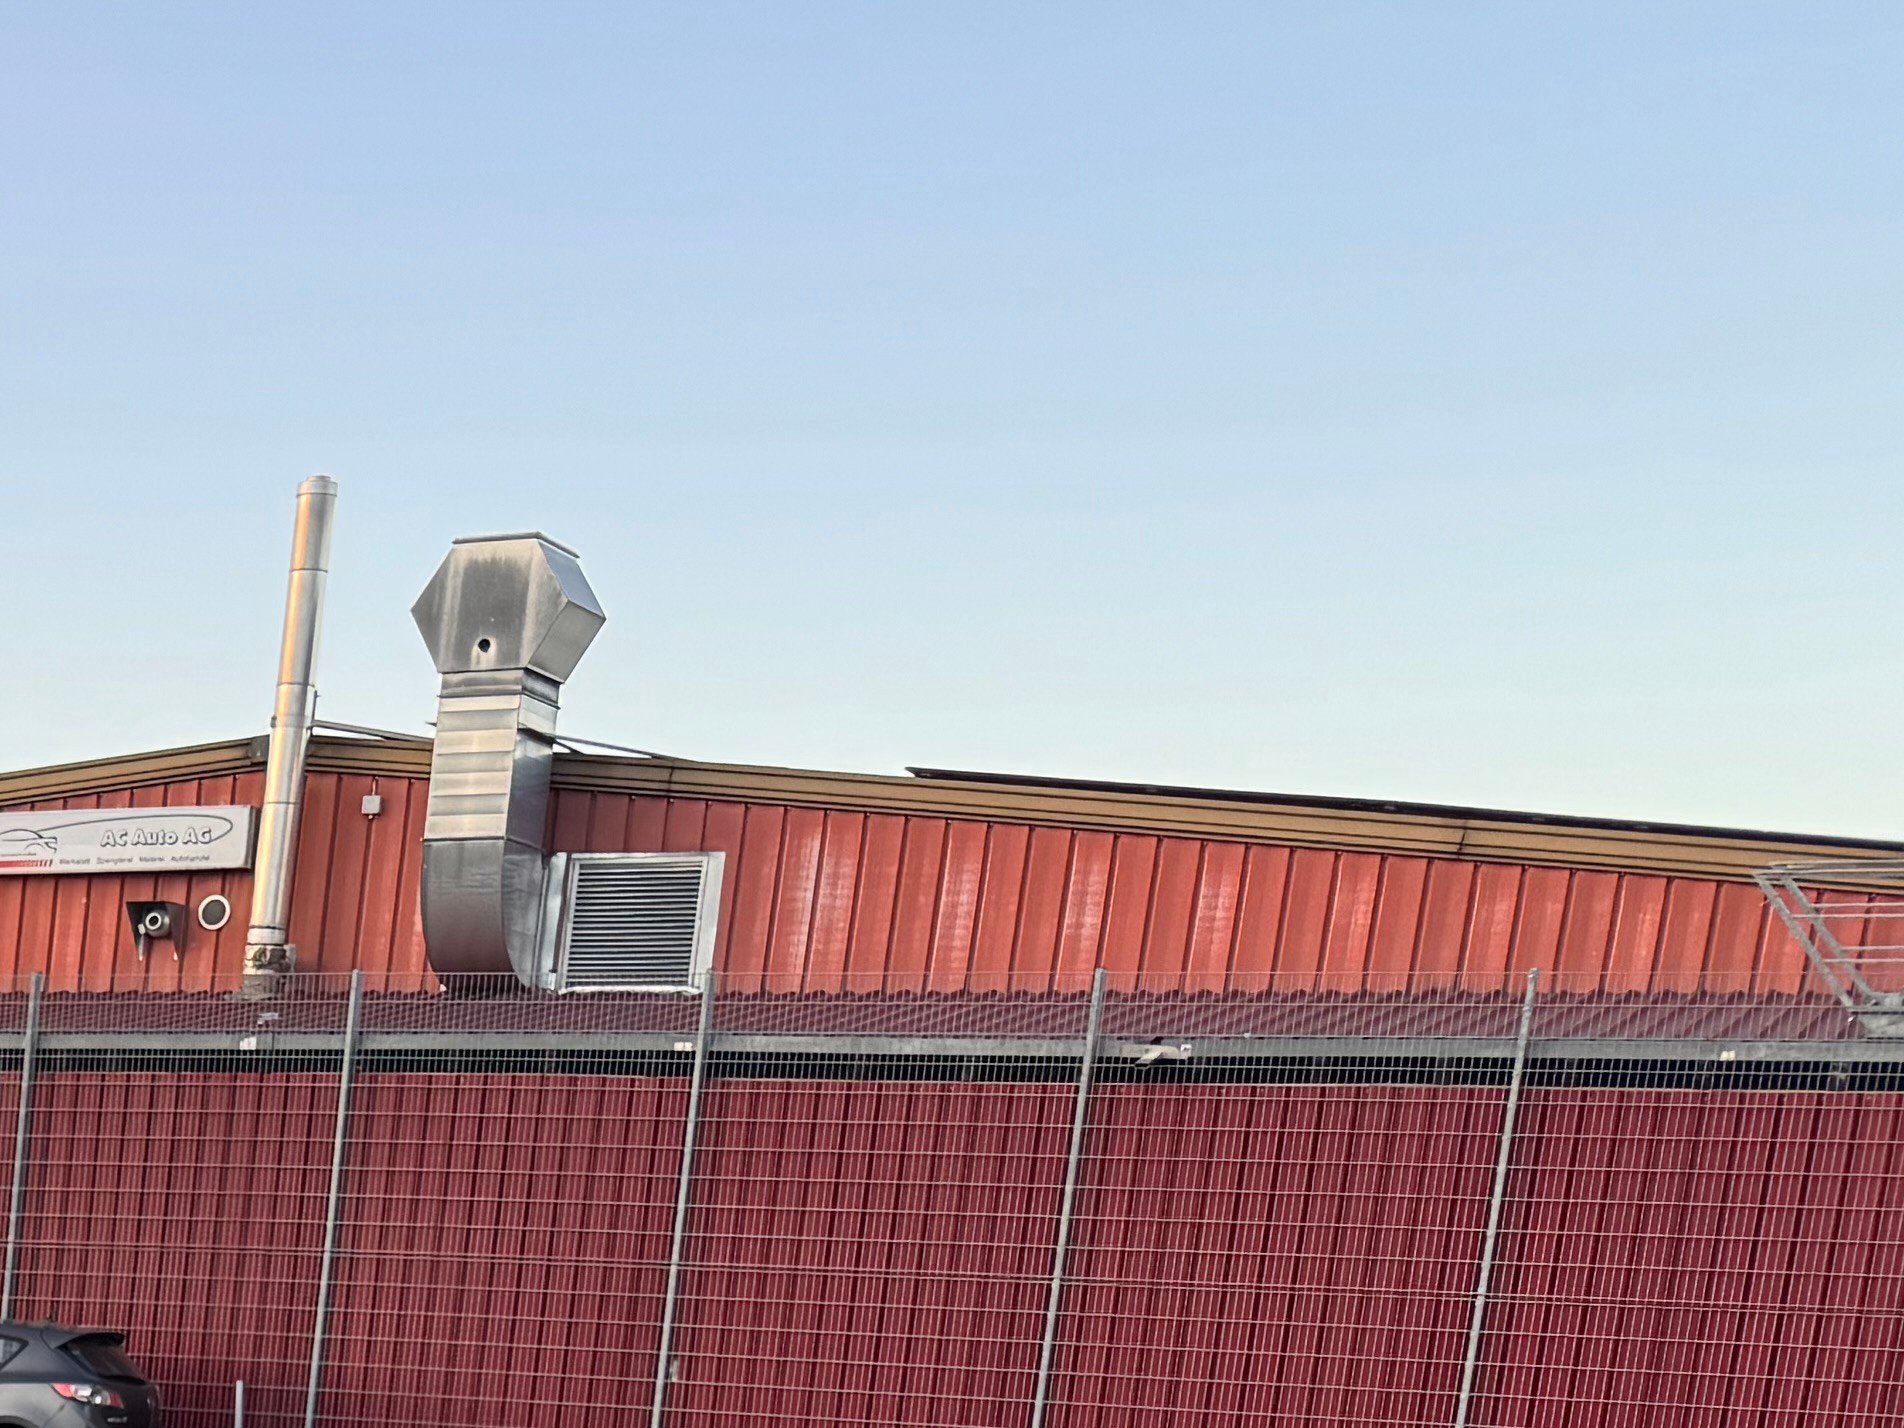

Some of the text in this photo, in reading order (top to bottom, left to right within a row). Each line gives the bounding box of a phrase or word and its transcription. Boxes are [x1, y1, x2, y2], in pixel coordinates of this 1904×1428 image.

[100, 826, 213, 847] AC Auto AG
